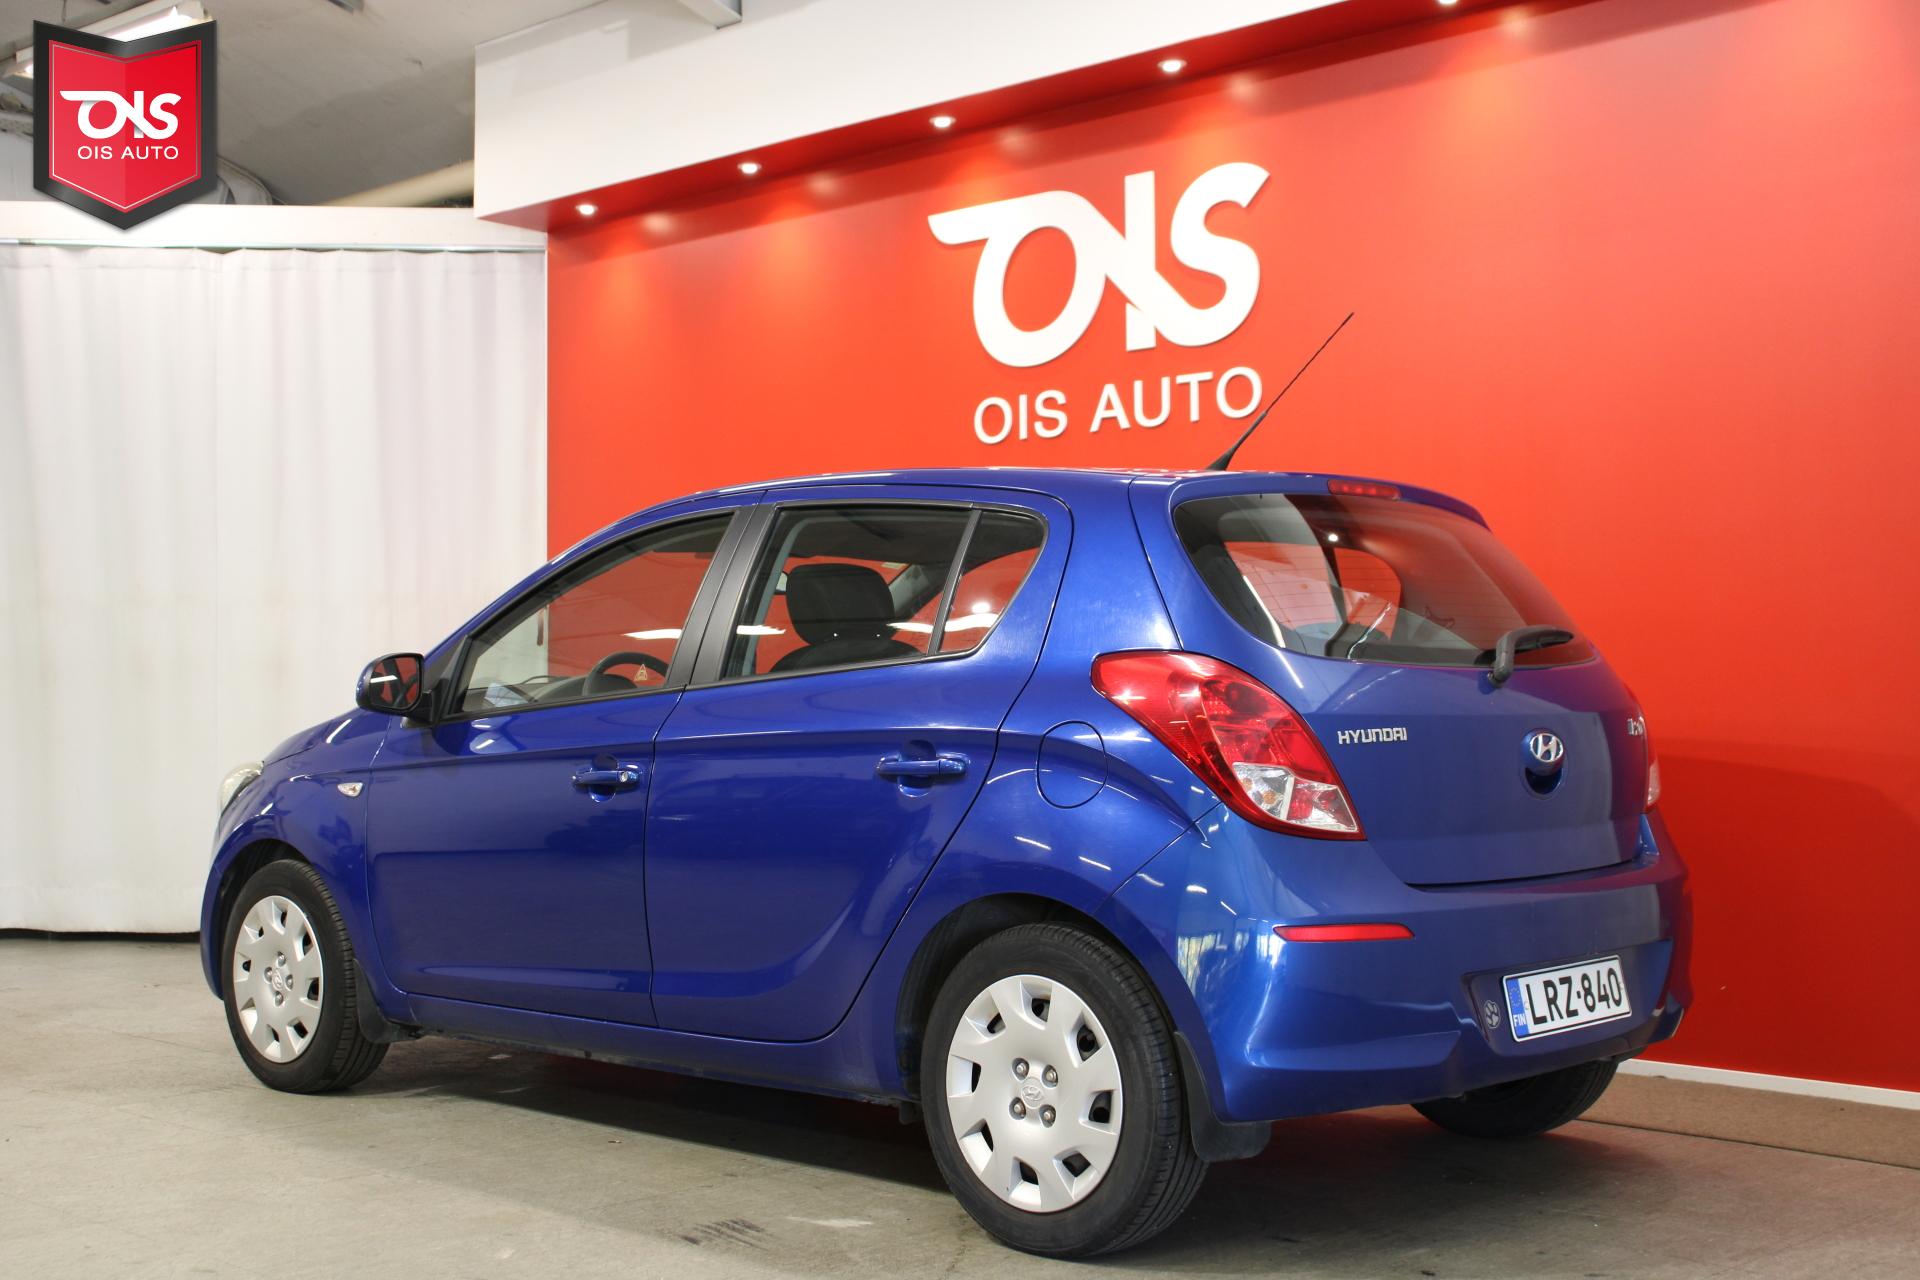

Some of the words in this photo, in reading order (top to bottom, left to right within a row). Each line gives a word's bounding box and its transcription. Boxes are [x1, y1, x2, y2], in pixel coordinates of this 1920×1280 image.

[973, 390, 1068, 444] OIS
[1089, 366, 1263, 433] AUTO
[1337, 727, 1408, 744] HYUNDAI
[1512, 1012, 1527, 1027] FIN
